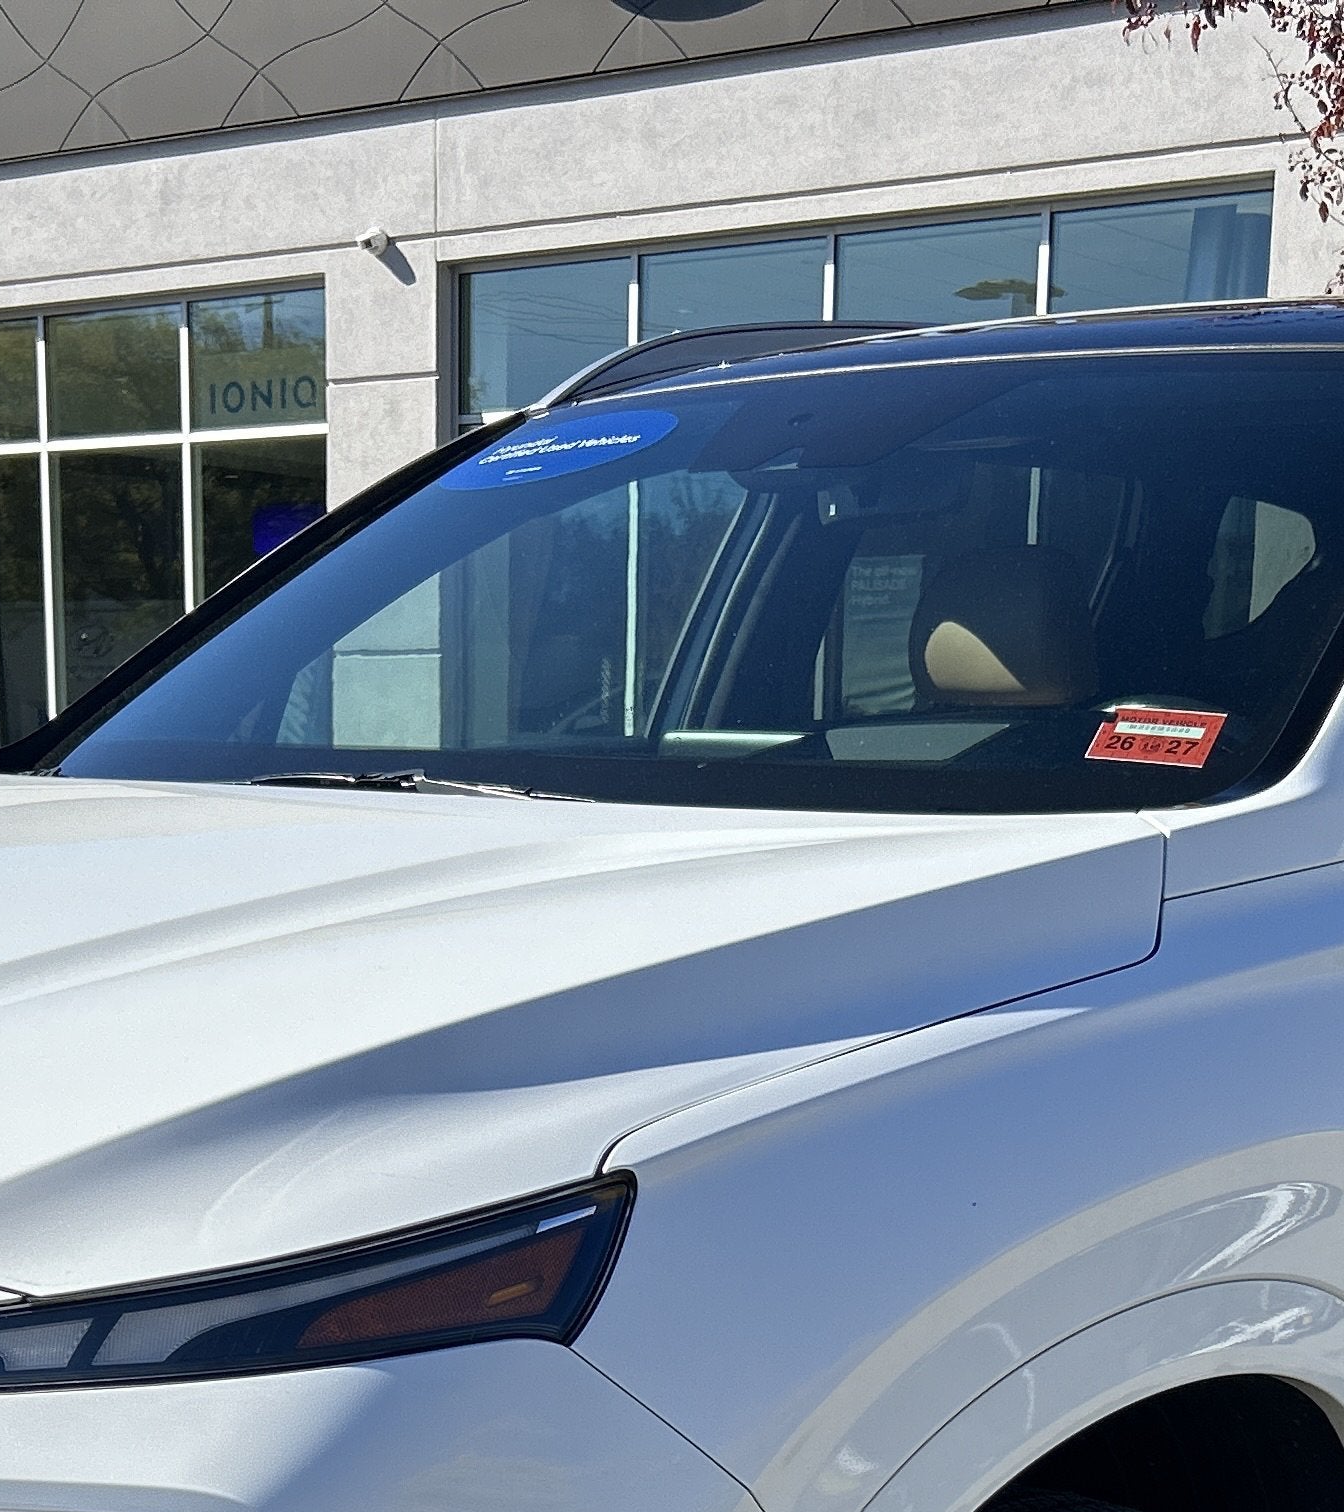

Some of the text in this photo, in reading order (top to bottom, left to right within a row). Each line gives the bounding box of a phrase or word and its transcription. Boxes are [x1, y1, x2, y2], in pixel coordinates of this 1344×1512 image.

[209, 375, 317, 415] IONIQ
[1103, 734, 1200, 756] 26 27
